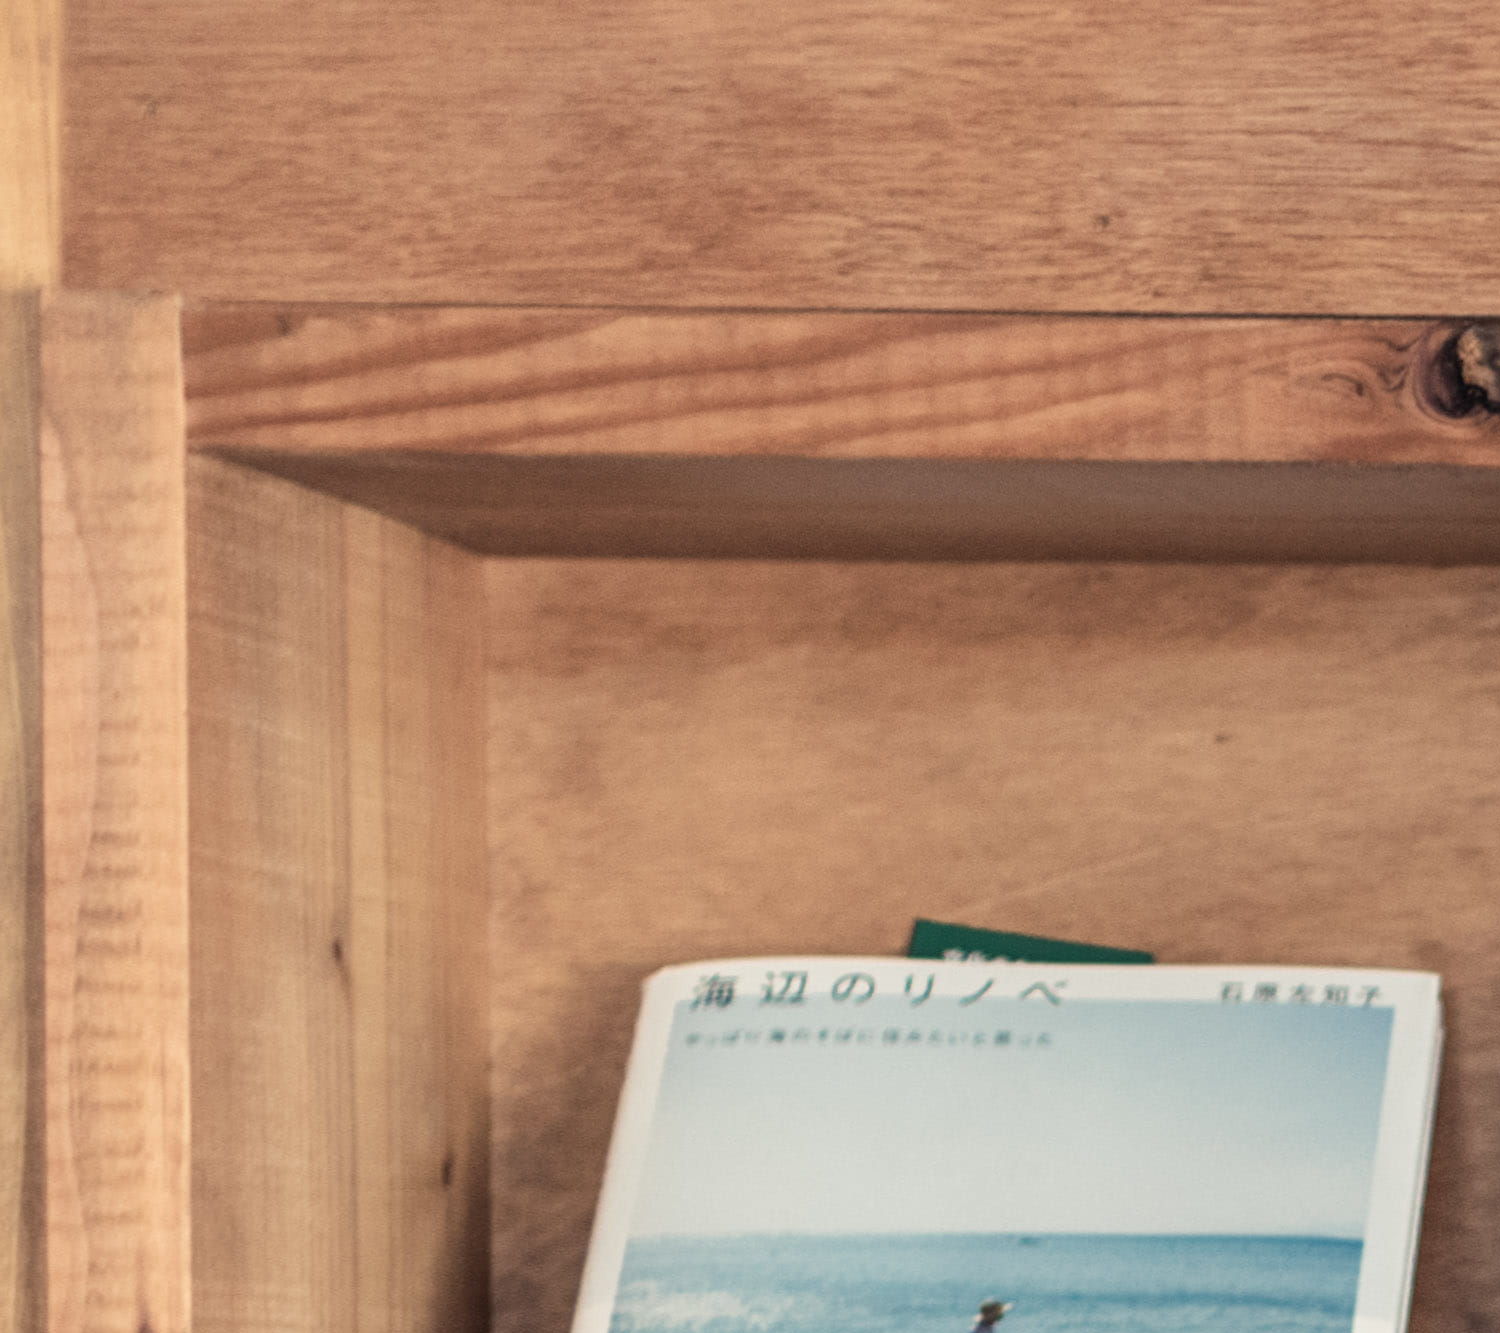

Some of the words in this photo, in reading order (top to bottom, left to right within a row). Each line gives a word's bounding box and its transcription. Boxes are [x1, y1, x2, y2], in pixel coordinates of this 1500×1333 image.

[690, 969, 1069, 1010] 海辺のリノベ
